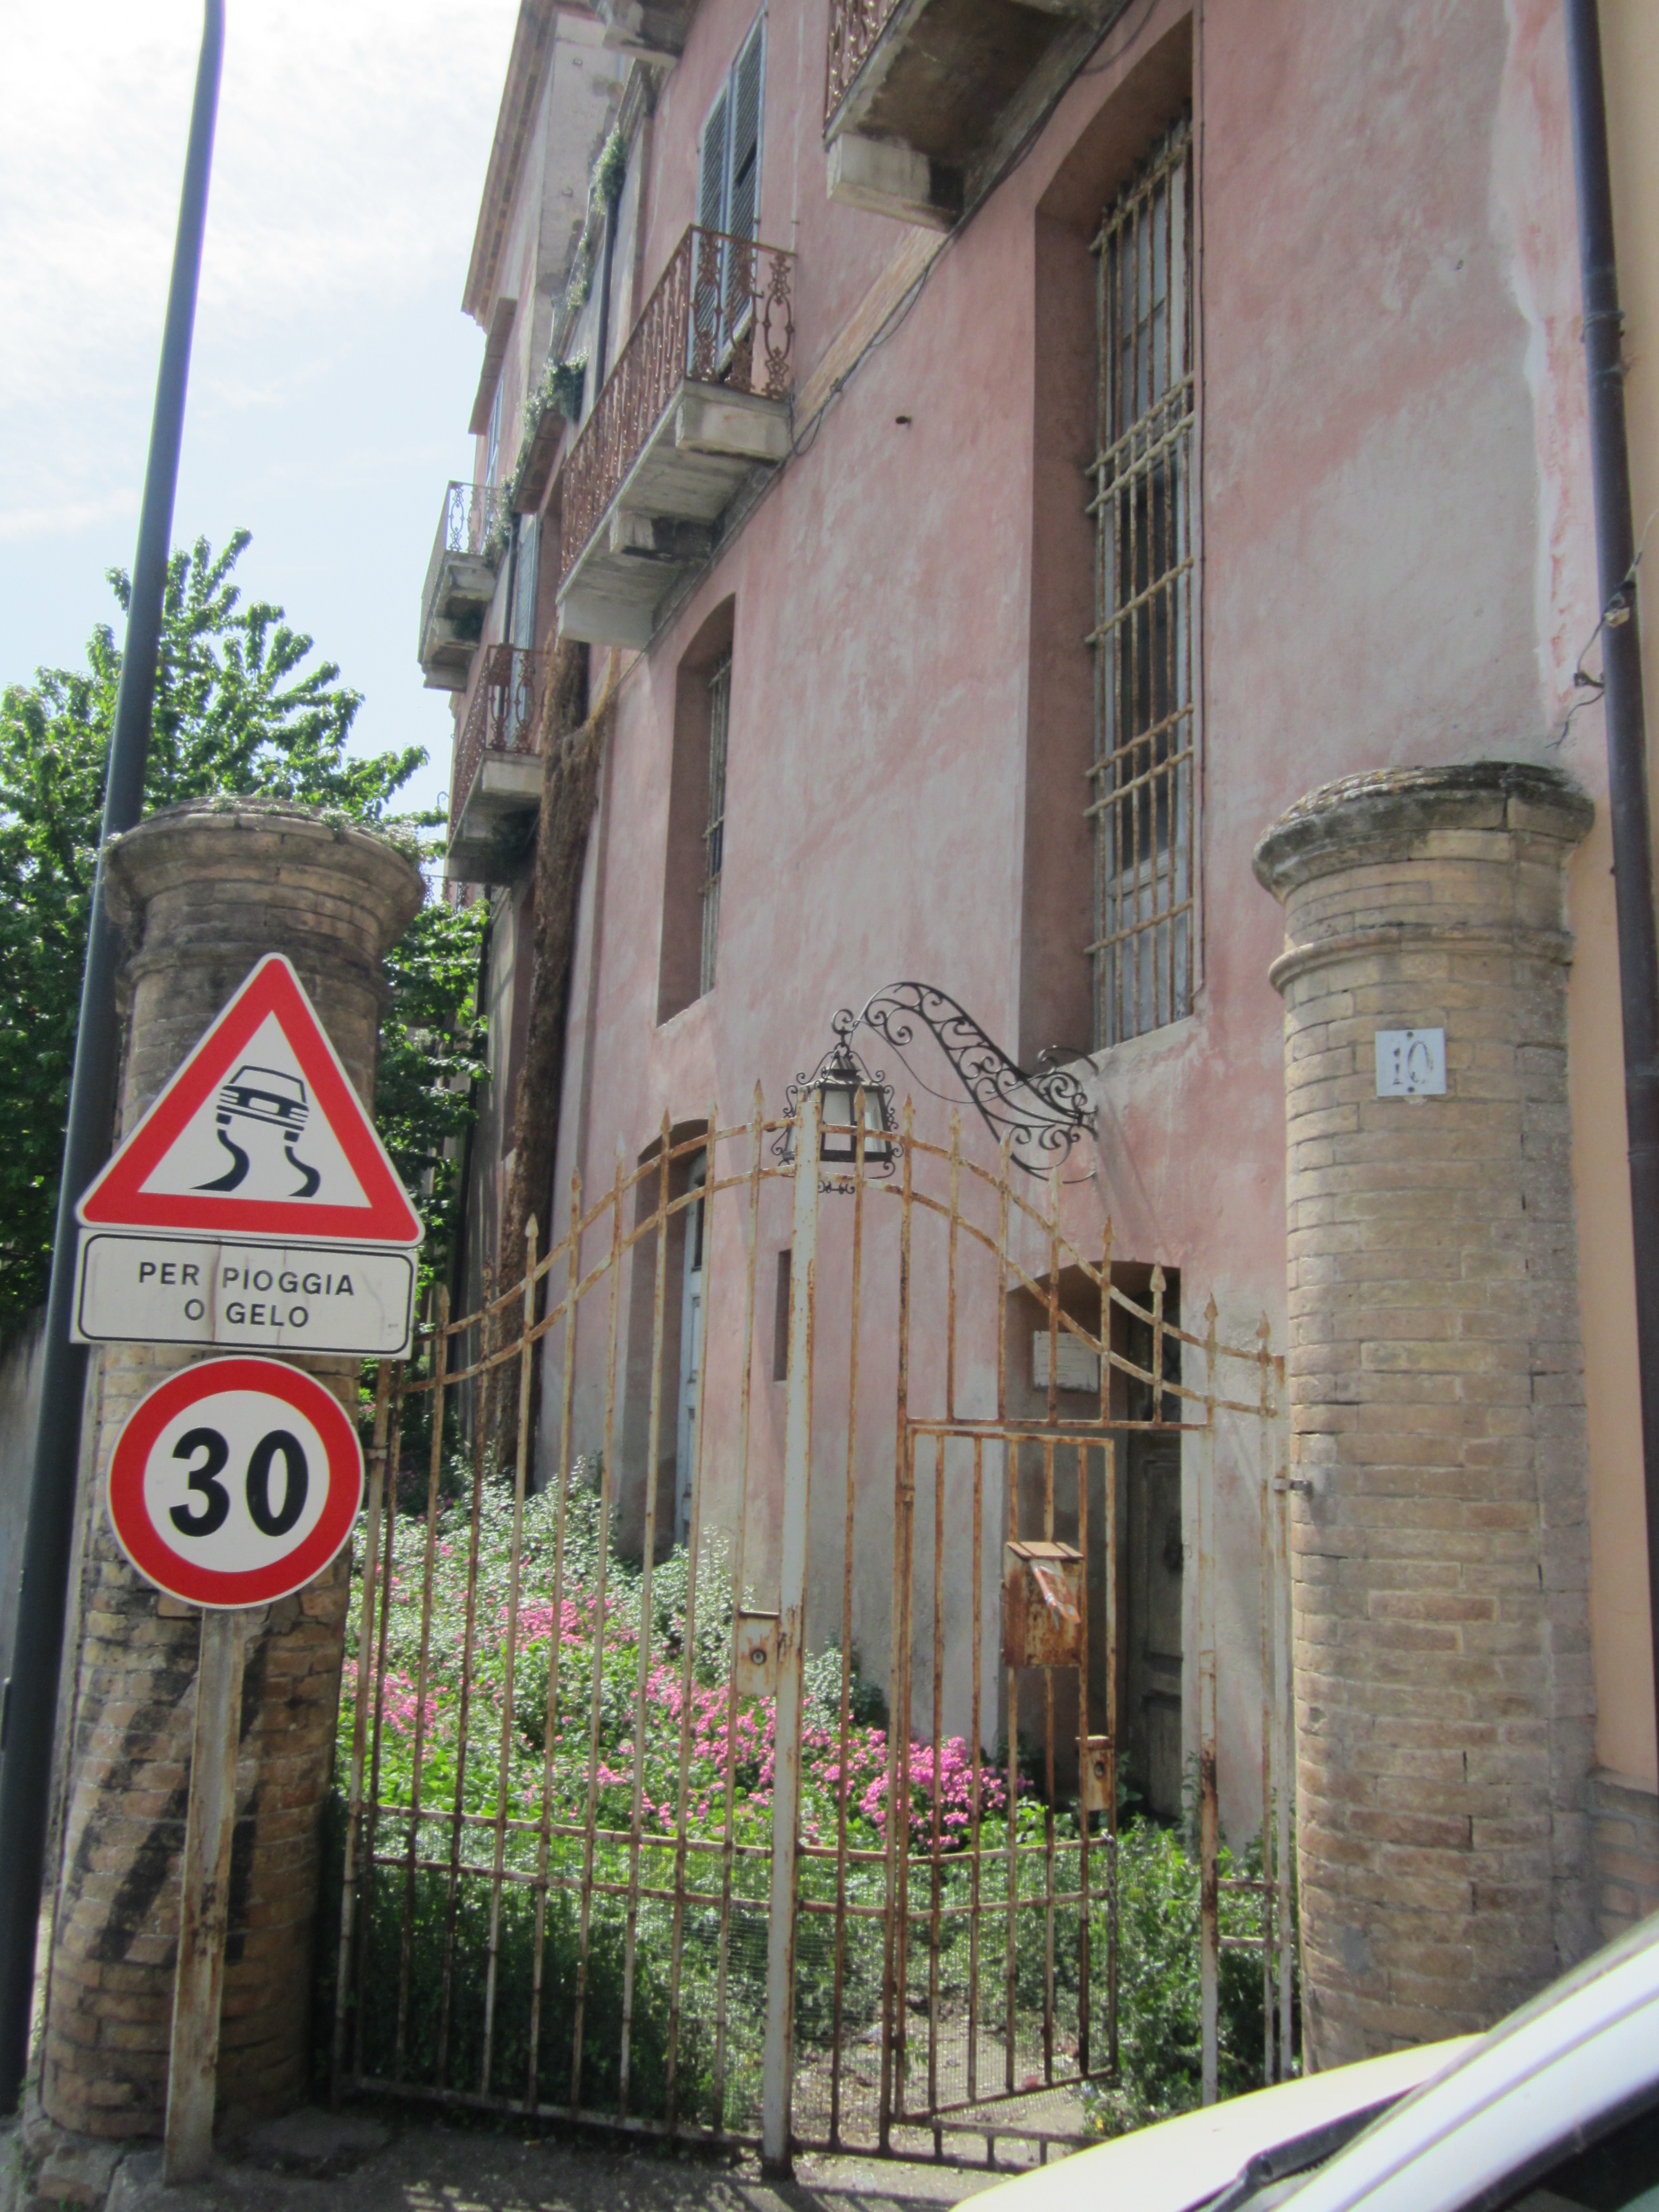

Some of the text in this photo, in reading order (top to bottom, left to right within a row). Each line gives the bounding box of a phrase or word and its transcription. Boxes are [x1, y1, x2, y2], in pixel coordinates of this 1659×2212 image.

[138, 1261, 354, 1296] PER PIOGGIA
[184, 1298, 309, 1328] O GELO
[169, 1427, 309, 1537] 30
